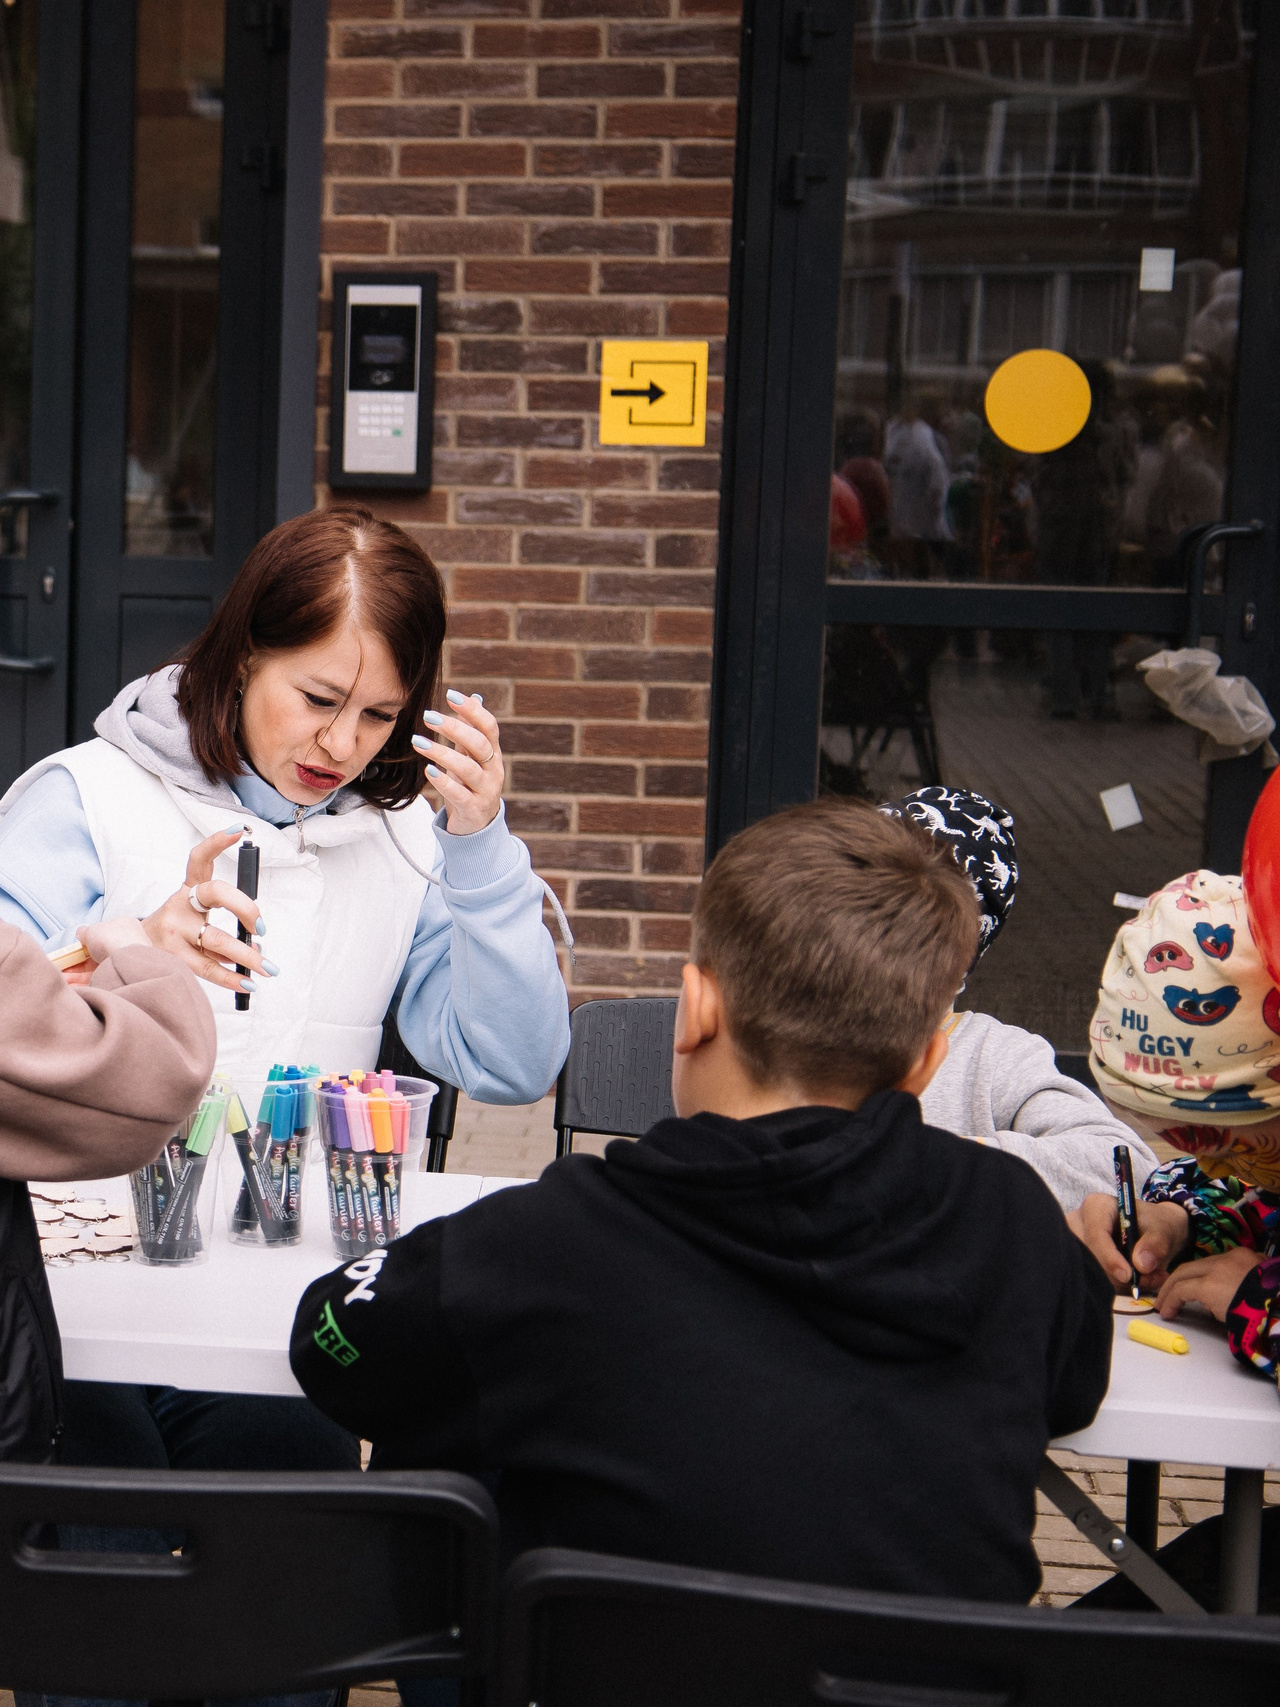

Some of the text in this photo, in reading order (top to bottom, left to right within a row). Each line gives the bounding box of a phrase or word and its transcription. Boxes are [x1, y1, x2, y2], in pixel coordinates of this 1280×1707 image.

[1121, 1007, 1149, 1032] HU
[1139, 1035, 1195, 1057] GGY
[1124, 1051, 1184, 1078] WUG
[288, 1173, 300, 1210] Painter
[361, 1155, 379, 1196] Acrylic
[369, 1195, 384, 1233] Painter
